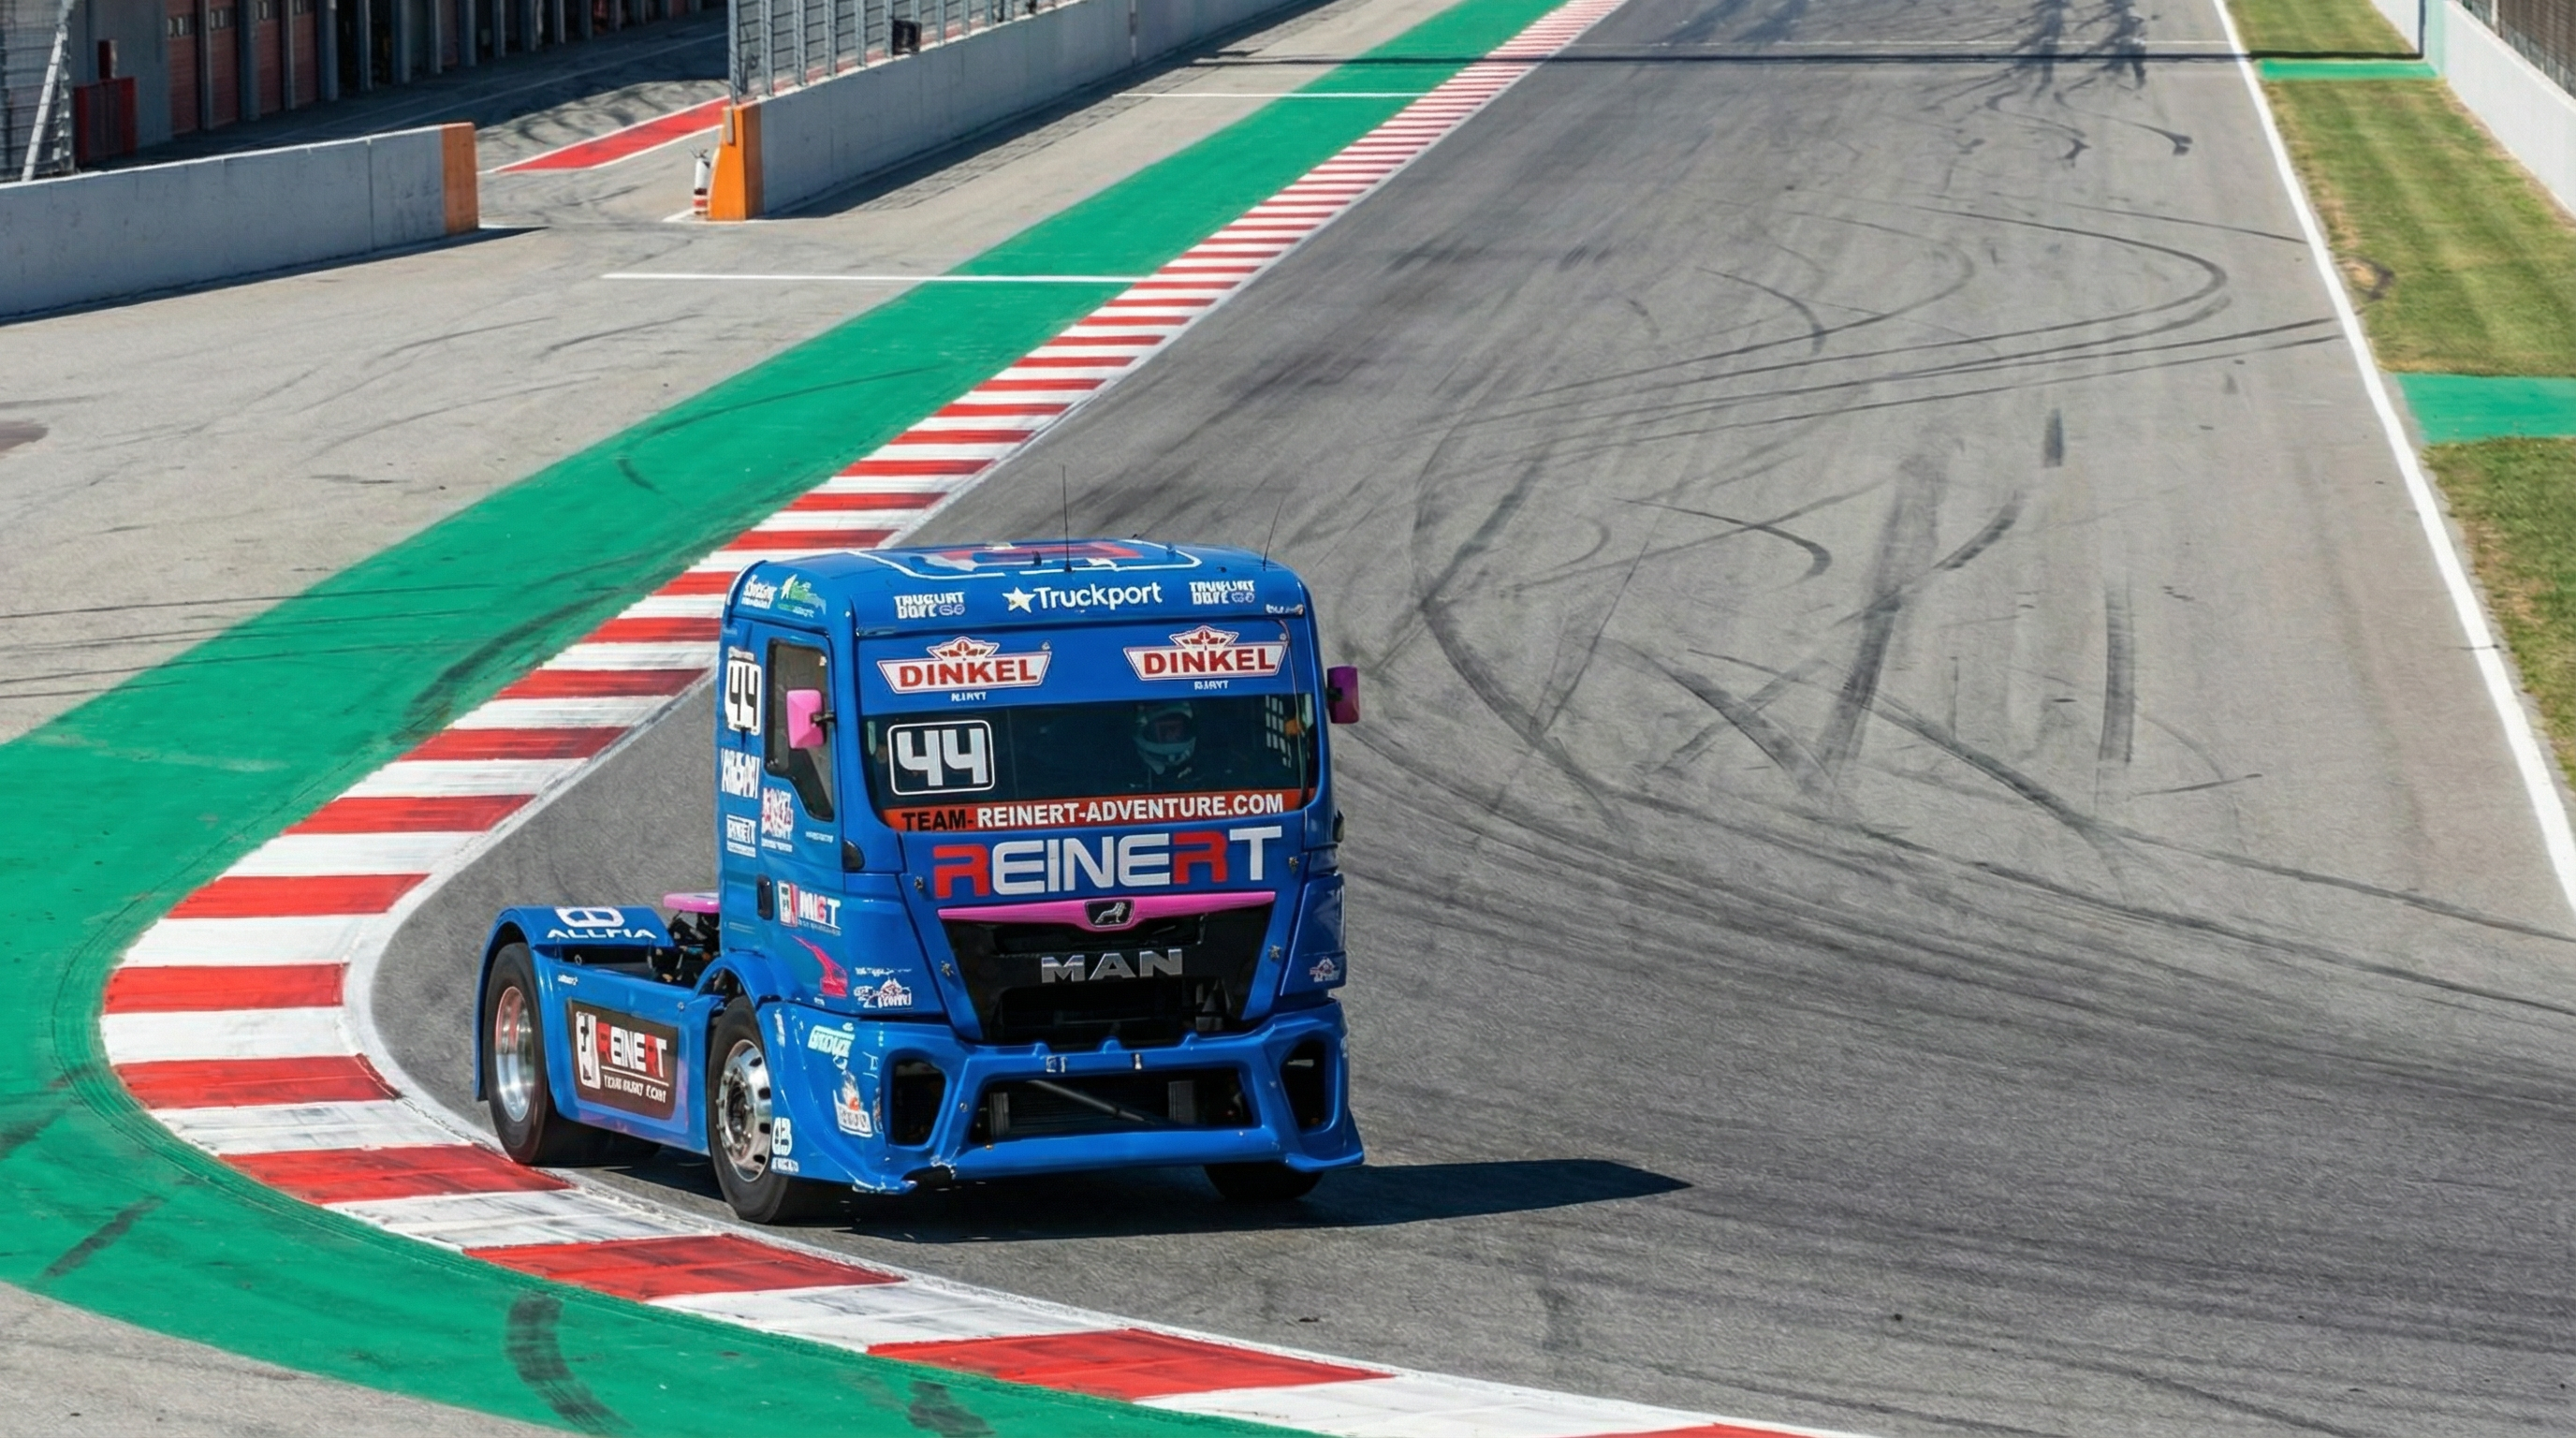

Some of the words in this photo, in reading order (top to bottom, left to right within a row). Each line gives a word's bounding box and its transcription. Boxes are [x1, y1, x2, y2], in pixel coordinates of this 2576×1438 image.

[1033, 581, 1163, 609] Truckport
[900, 659, 1037, 687] DINKEL
[1144, 648, 1276, 675] DINKEL
[729, 665, 759, 727] 44
[896, 727, 988, 786] 44
[932, 826, 1282, 898] REINERT
[1041, 948, 1183, 983] MAN
[595, 1021, 667, 1078] REINERT
